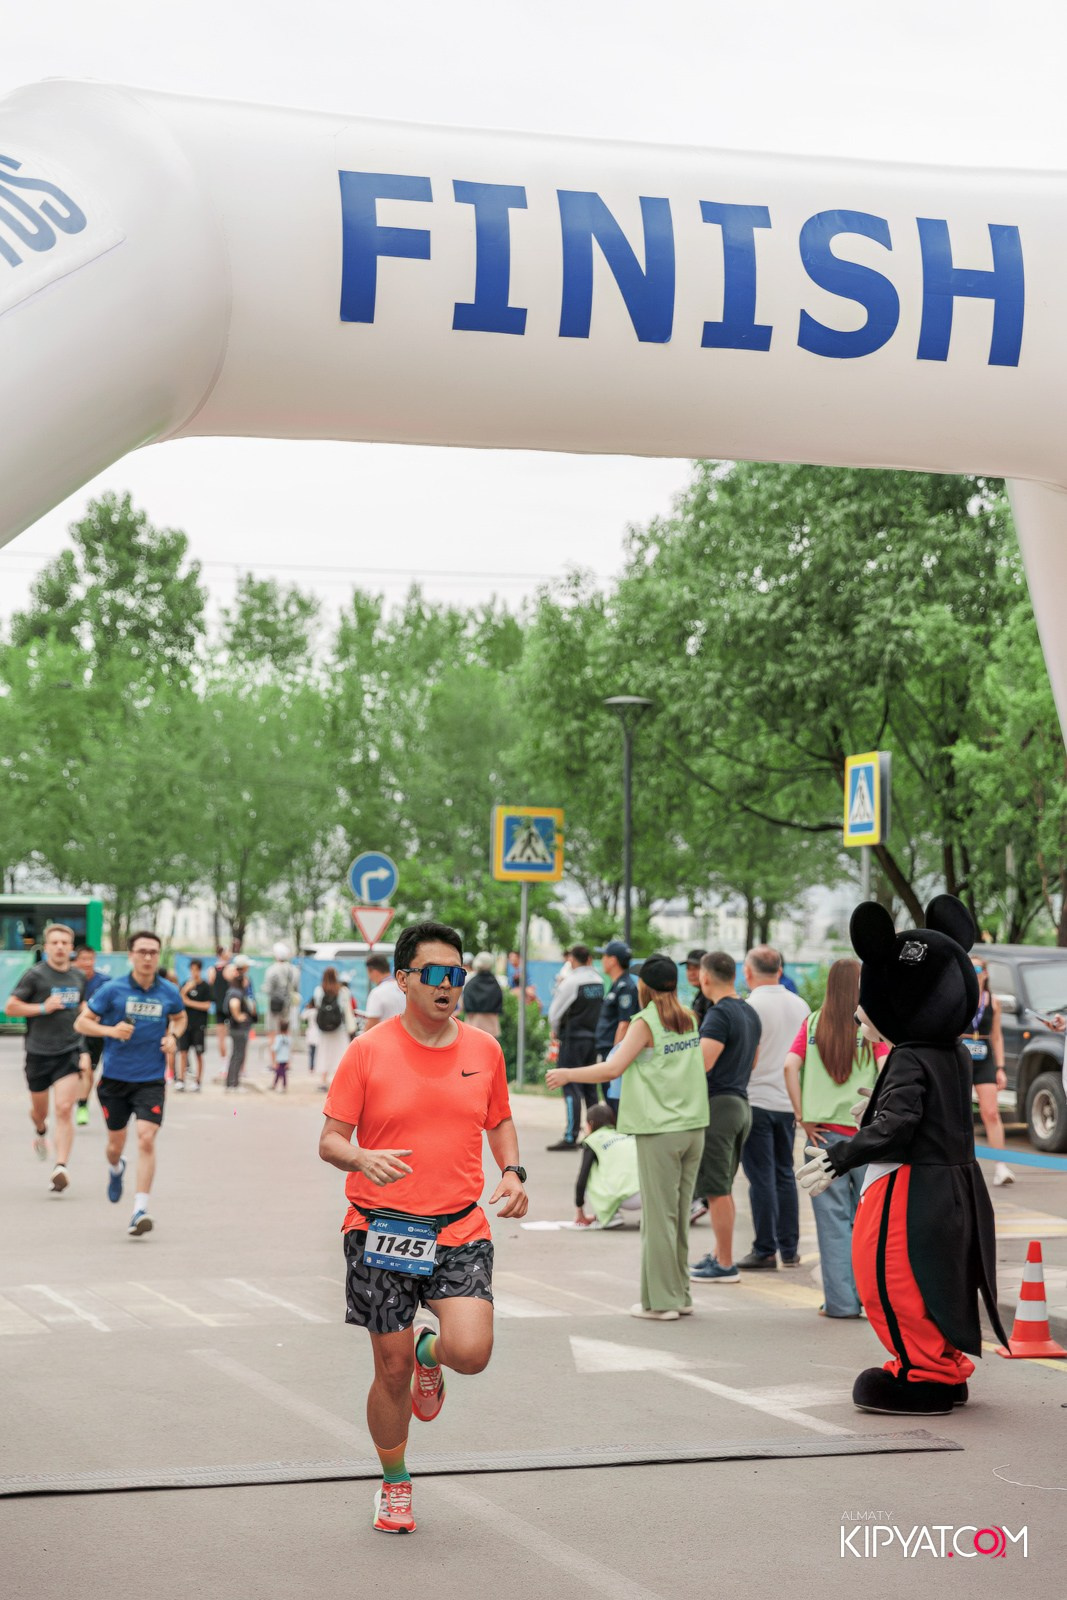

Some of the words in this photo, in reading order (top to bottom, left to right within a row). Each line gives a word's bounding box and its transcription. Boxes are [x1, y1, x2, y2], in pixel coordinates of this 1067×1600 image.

[338, 170, 1024, 367] FINISH
[663, 1037, 700, 1055] ВОЛОНТЕ
[376, 1235, 427, 1257] 1145
